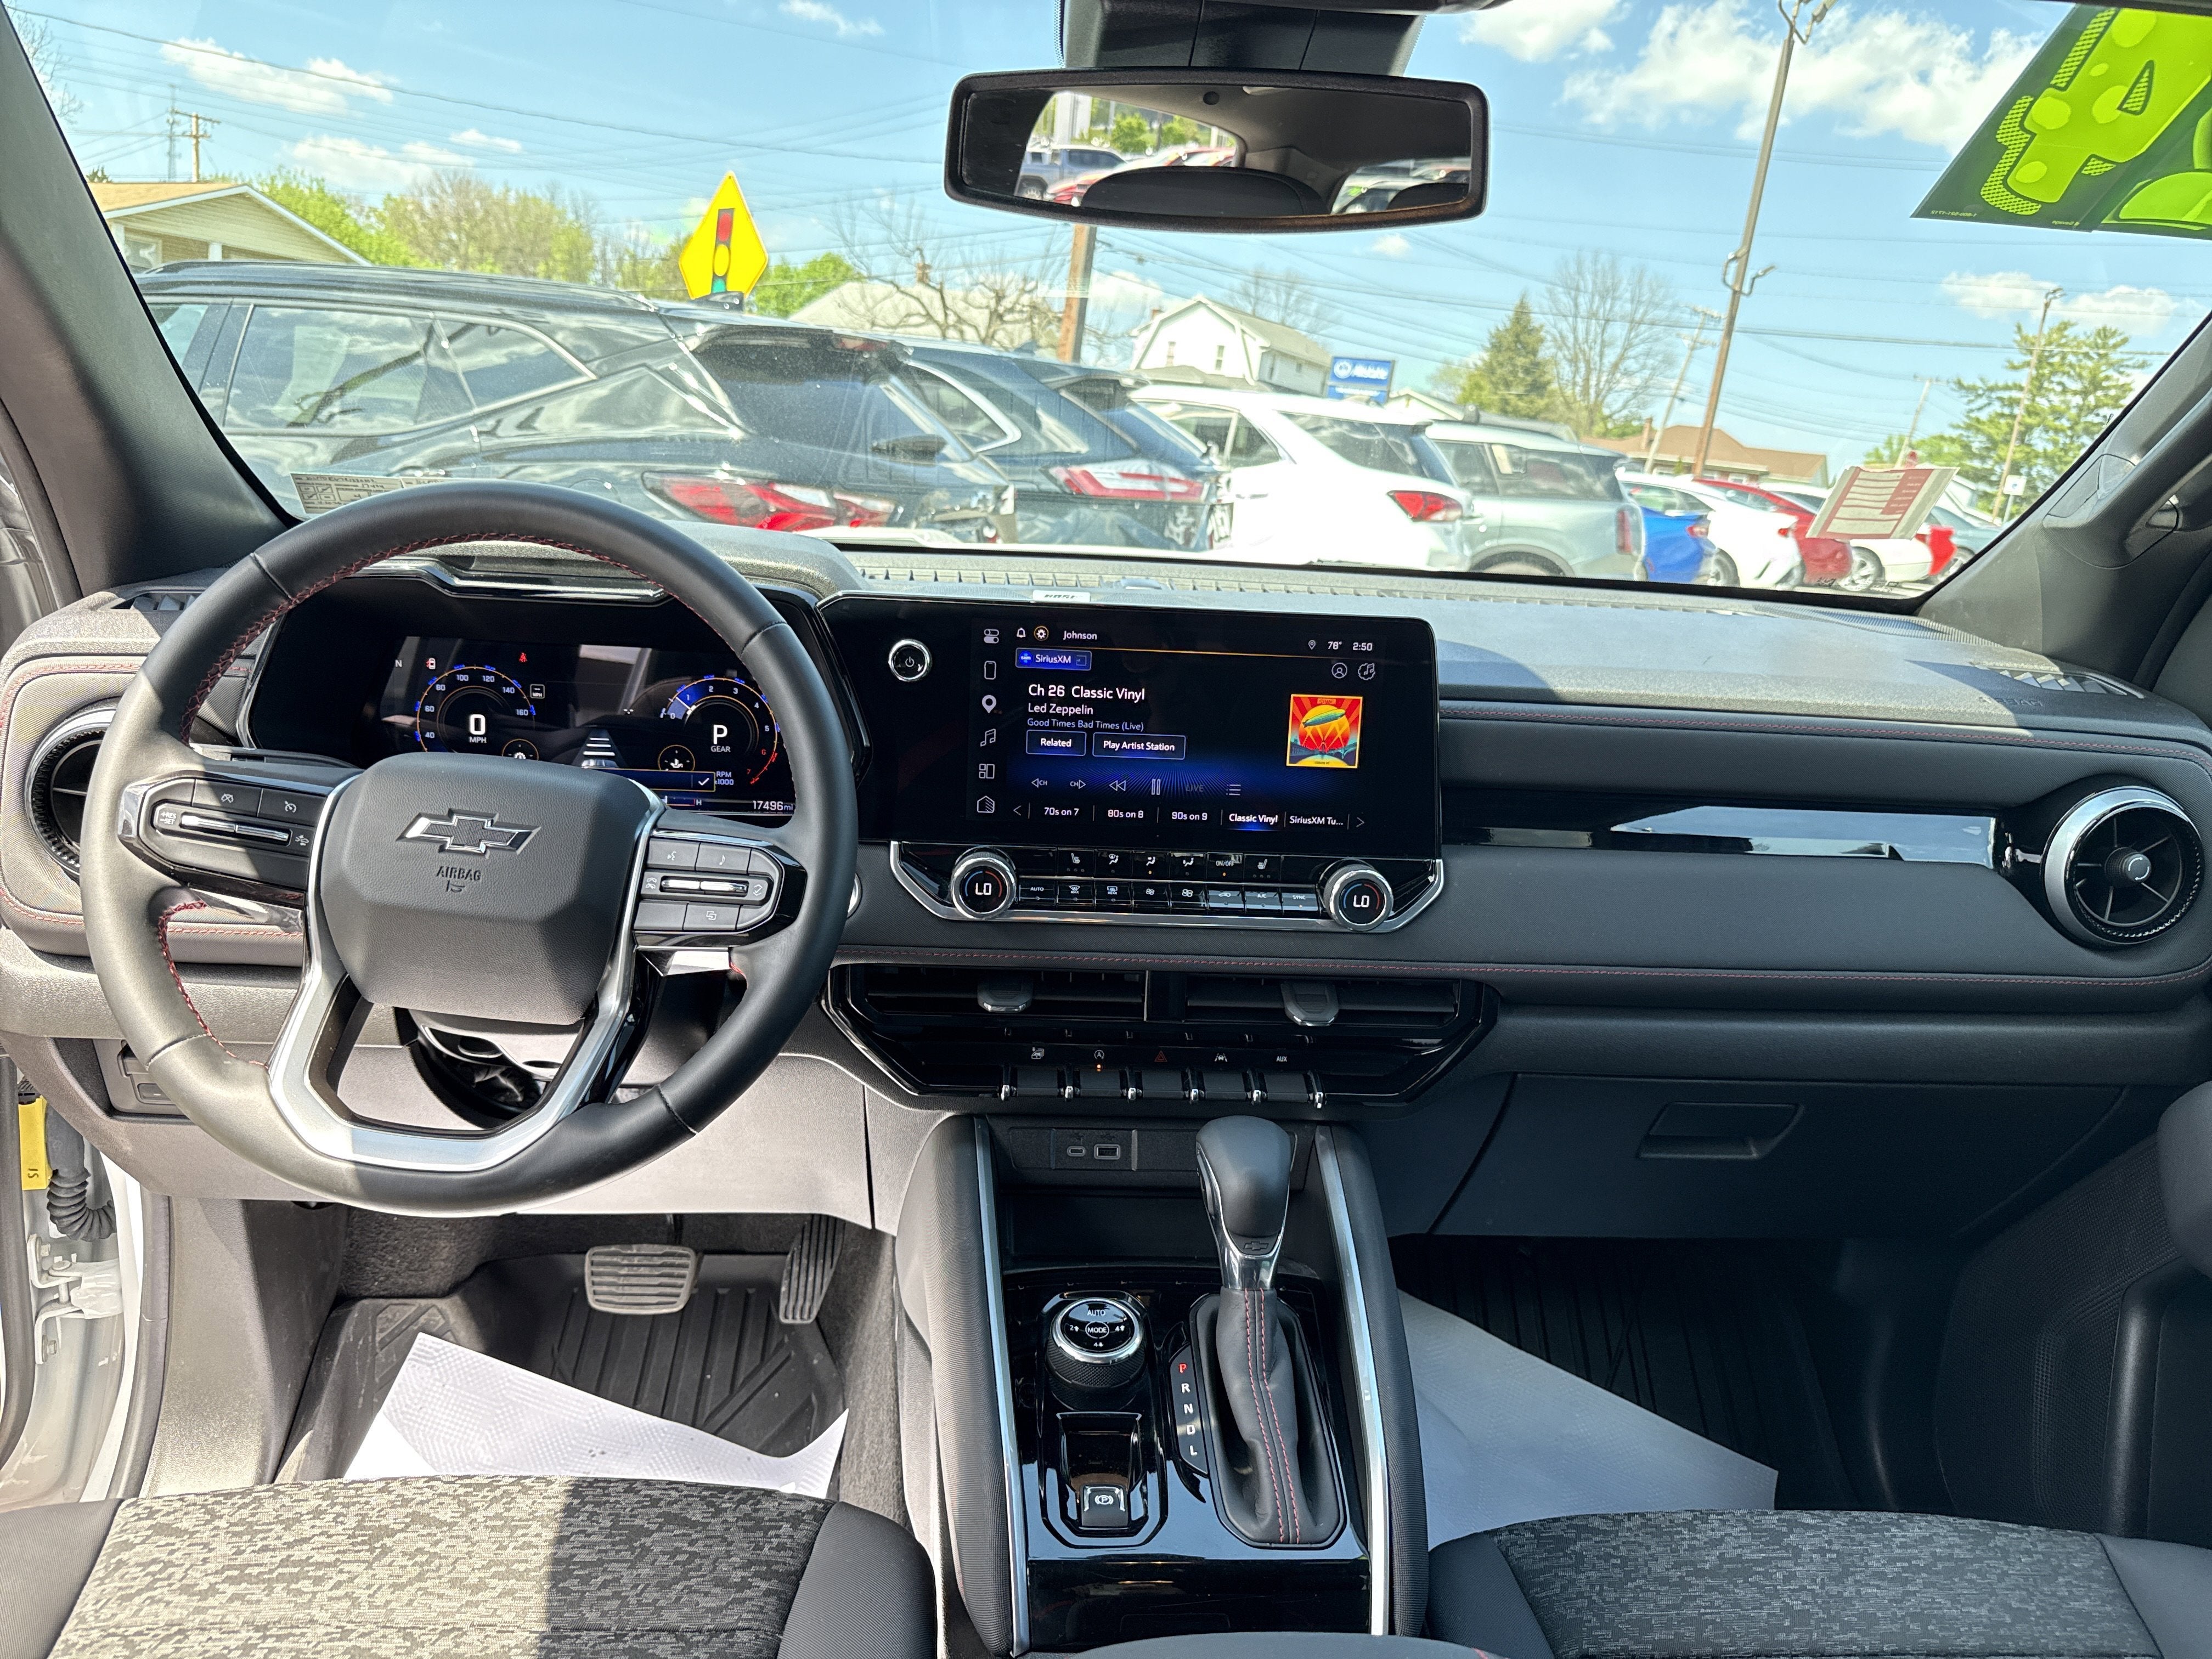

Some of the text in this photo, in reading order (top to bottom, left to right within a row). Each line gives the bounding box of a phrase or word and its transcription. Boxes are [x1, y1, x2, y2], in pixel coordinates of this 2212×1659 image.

[1063, 630, 1097, 640] Johnson
[1328, 641, 1373, 651] 78° 2:50
[1035, 654, 1071, 664] SiriusXM
[1028, 684, 1145, 703] Ch 26 Classic Vinyl
[1028, 702, 1093, 716] Led Zeppelin
[470, 714, 486, 735] 0
[1027, 718, 1144, 732] Good Times Bad Times (Live)
[713, 724, 728, 745] P
[1040, 737, 1072, 747] Related
[1103, 740, 1175, 751] Play Artist Station
[752, 800, 783, 811] 17496
[1044, 806, 1059, 816] 70s
[1074, 808, 1079, 816] 7
[1108, 809, 1124, 818] 80s
[1137, 810, 1144, 819] 8
[1171, 811, 1188, 820] 90s
[1201, 812, 1207, 821] 9
[1229, 813, 1278, 824] Classic Vinyl
[1289, 815, 1344, 826] SiriusXM Tu...
[437, 866, 482, 881] AIRBAG
[975, 883, 992, 896] LO
[1353, 895, 1370, 908] LO
[1180, 1363, 1187, 1373] P
[1181, 1383, 1190, 1393] R
[1183, 1403, 1193, 1414] N
[1187, 1425, 1195, 1435] D
[1189, 1445, 1198, 1456] L
